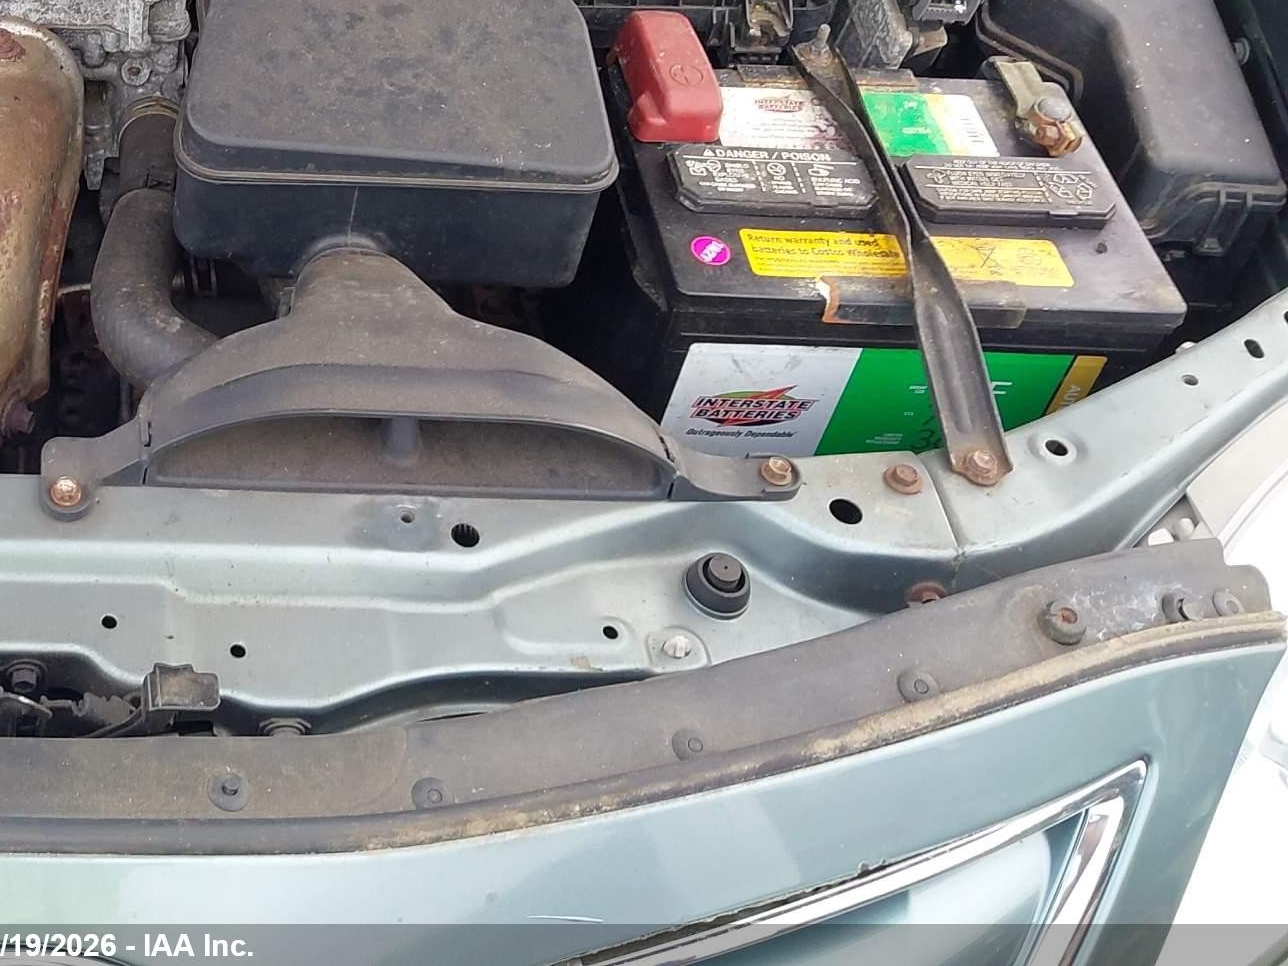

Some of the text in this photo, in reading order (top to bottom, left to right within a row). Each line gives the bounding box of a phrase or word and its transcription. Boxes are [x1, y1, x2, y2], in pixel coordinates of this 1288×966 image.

[754, 98, 805, 106] INTERSTATE
[716, 149, 769, 159] DANGER
[781, 152, 832, 161] POISON
[747, 234, 784, 243] Return
[785, 237, 830, 247] warranty
[854, 239, 879, 247] used
[751, 245, 900, 258] batteries to Costco Wholesale
[696, 397, 810, 410] INTERSTATE
[695, 408, 799, 419] BATTERIES
[686, 428, 795, 438] Outrageously Dependable
